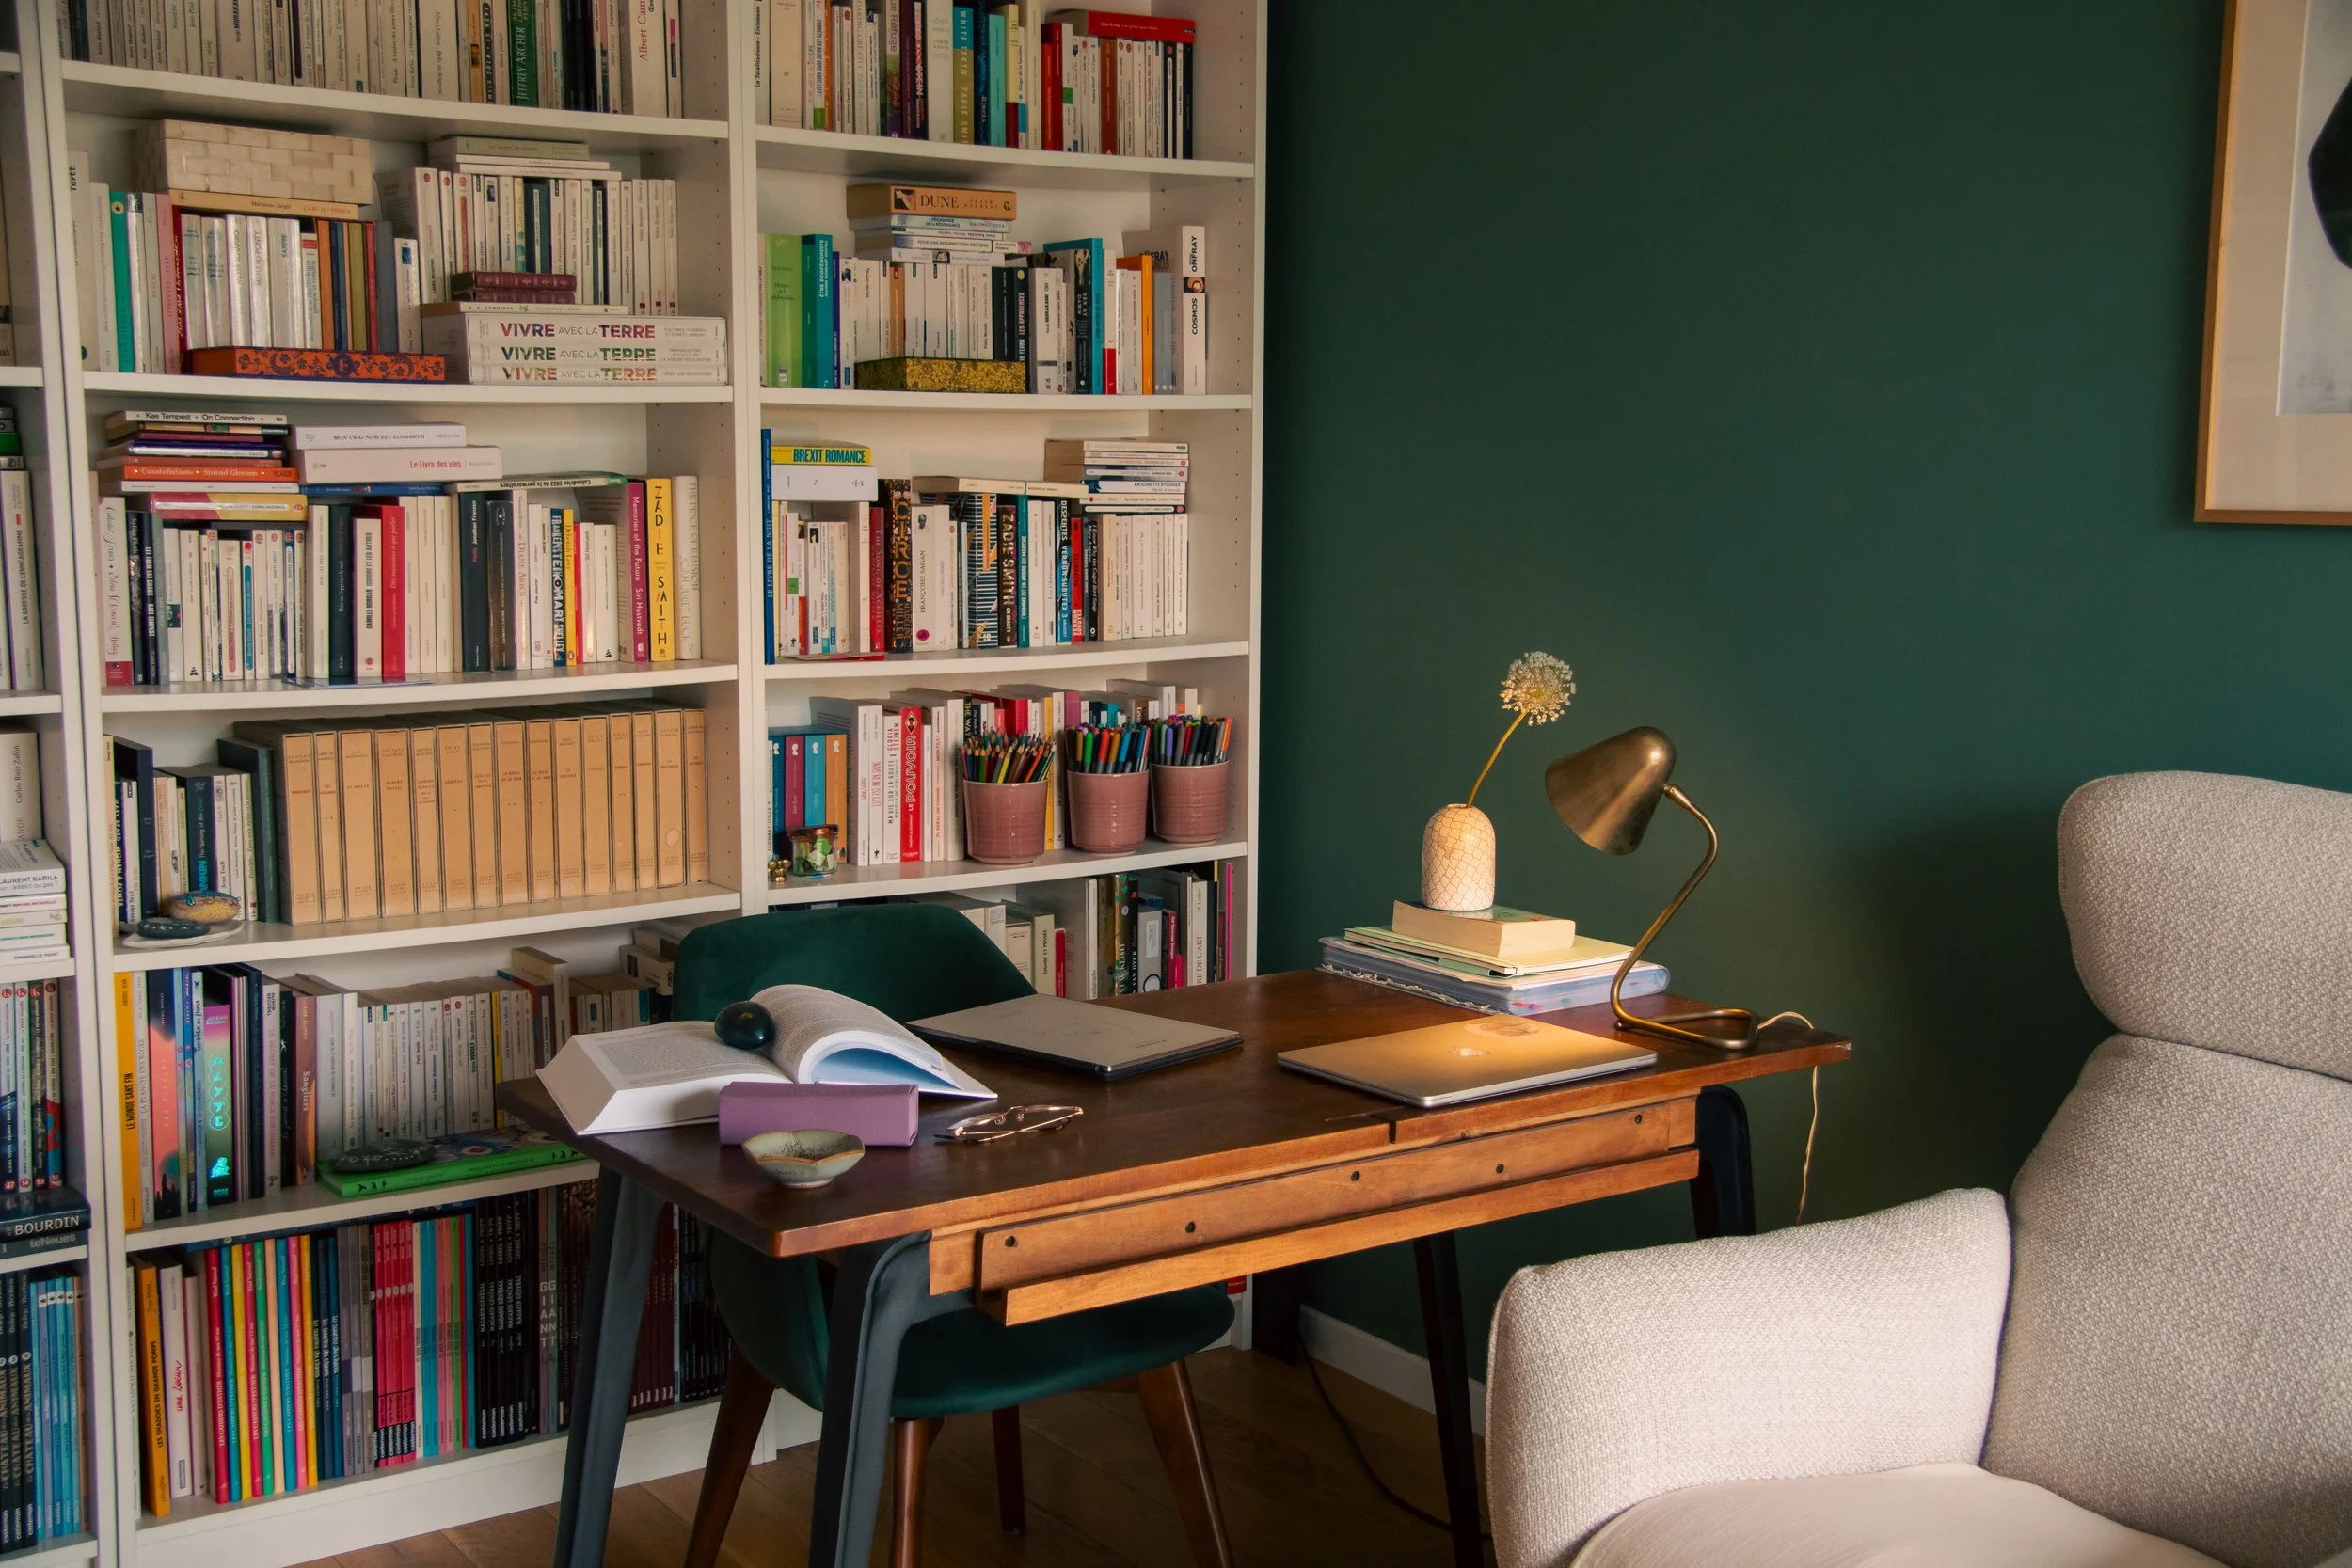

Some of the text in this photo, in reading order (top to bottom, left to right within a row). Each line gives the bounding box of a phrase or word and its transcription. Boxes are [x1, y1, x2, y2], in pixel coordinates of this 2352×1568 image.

[637, 0, 648, 61] Albert Cam
[889, 14, 898, 53] Refuge
[515, 26, 529, 100] JEFFREY ARCHER
[960, 86, 968, 115] ZADIE
[68, 166, 77, 191] Tartt
[919, 194, 960, 209] DUNE
[1083, 308, 1088, 317] AT
[500, 322, 555, 338] VIVRE
[558, 326, 583, 335] AVEC
[584, 326, 598, 335] LA
[598, 324, 656, 339] TERRE
[501, 346, 556, 361] VIVRE
[559, 350, 584, 358] AVEC
[585, 350, 599, 358] LA
[599, 347, 656, 361] TERRE
[502, 367, 657, 381] VIVRE AVEC LA TERRE
[161, 412, 191, 421] Tempest
[214, 414, 255, 422] Connection
[410, 460, 462, 468] Le Livre des vies
[793, 448, 866, 464] BREXIT ROMANCE
[141, 467, 194, 476] Constellations
[632, 496, 642, 531] Memories
[654, 486, 666, 555] ZADIE
[131, 518, 140, 553] Sylvia Plath
[633, 533, 642, 542] of
[1002, 513, 1014, 555] ZADIE
[767, 553, 773, 562] DE
[893, 499, 911, 598] CIRCE
[551, 515, 564, 652] FRANKENSTEIN MARY SHELLEY
[635, 588, 644, 600] Siri
[767, 589, 773, 598] LE
[875, 578, 882, 587] OF
[1002, 559, 1014, 605] SMITH
[23, 612, 29, 625] LA
[635, 601, 644, 635] Hustvedt
[655, 576, 668, 644] SMITH
[896, 603, 904, 640] MILLER
[905, 735, 916, 812] LE POUVOIR
[124, 1073, 135, 1083] FIN
[137, 1039, 147, 1106] PLANÈTE SAGES
[124, 1084, 135, 1099] SANS
[301, 1070, 310, 1111] Sangliers
[124, 1101, 135, 1122] MONDE
[14, 1215, 79, 1236] BOURDIN
[29, 1233, 76, 1249] teNeues
[150, 1340, 163, 1435] SHADOKS GRANDE POMPE
[215, 1381, 224, 1411] D'ESTHER
[8, 1367, 22, 1480] CHÂTEAU ANIMAUX
